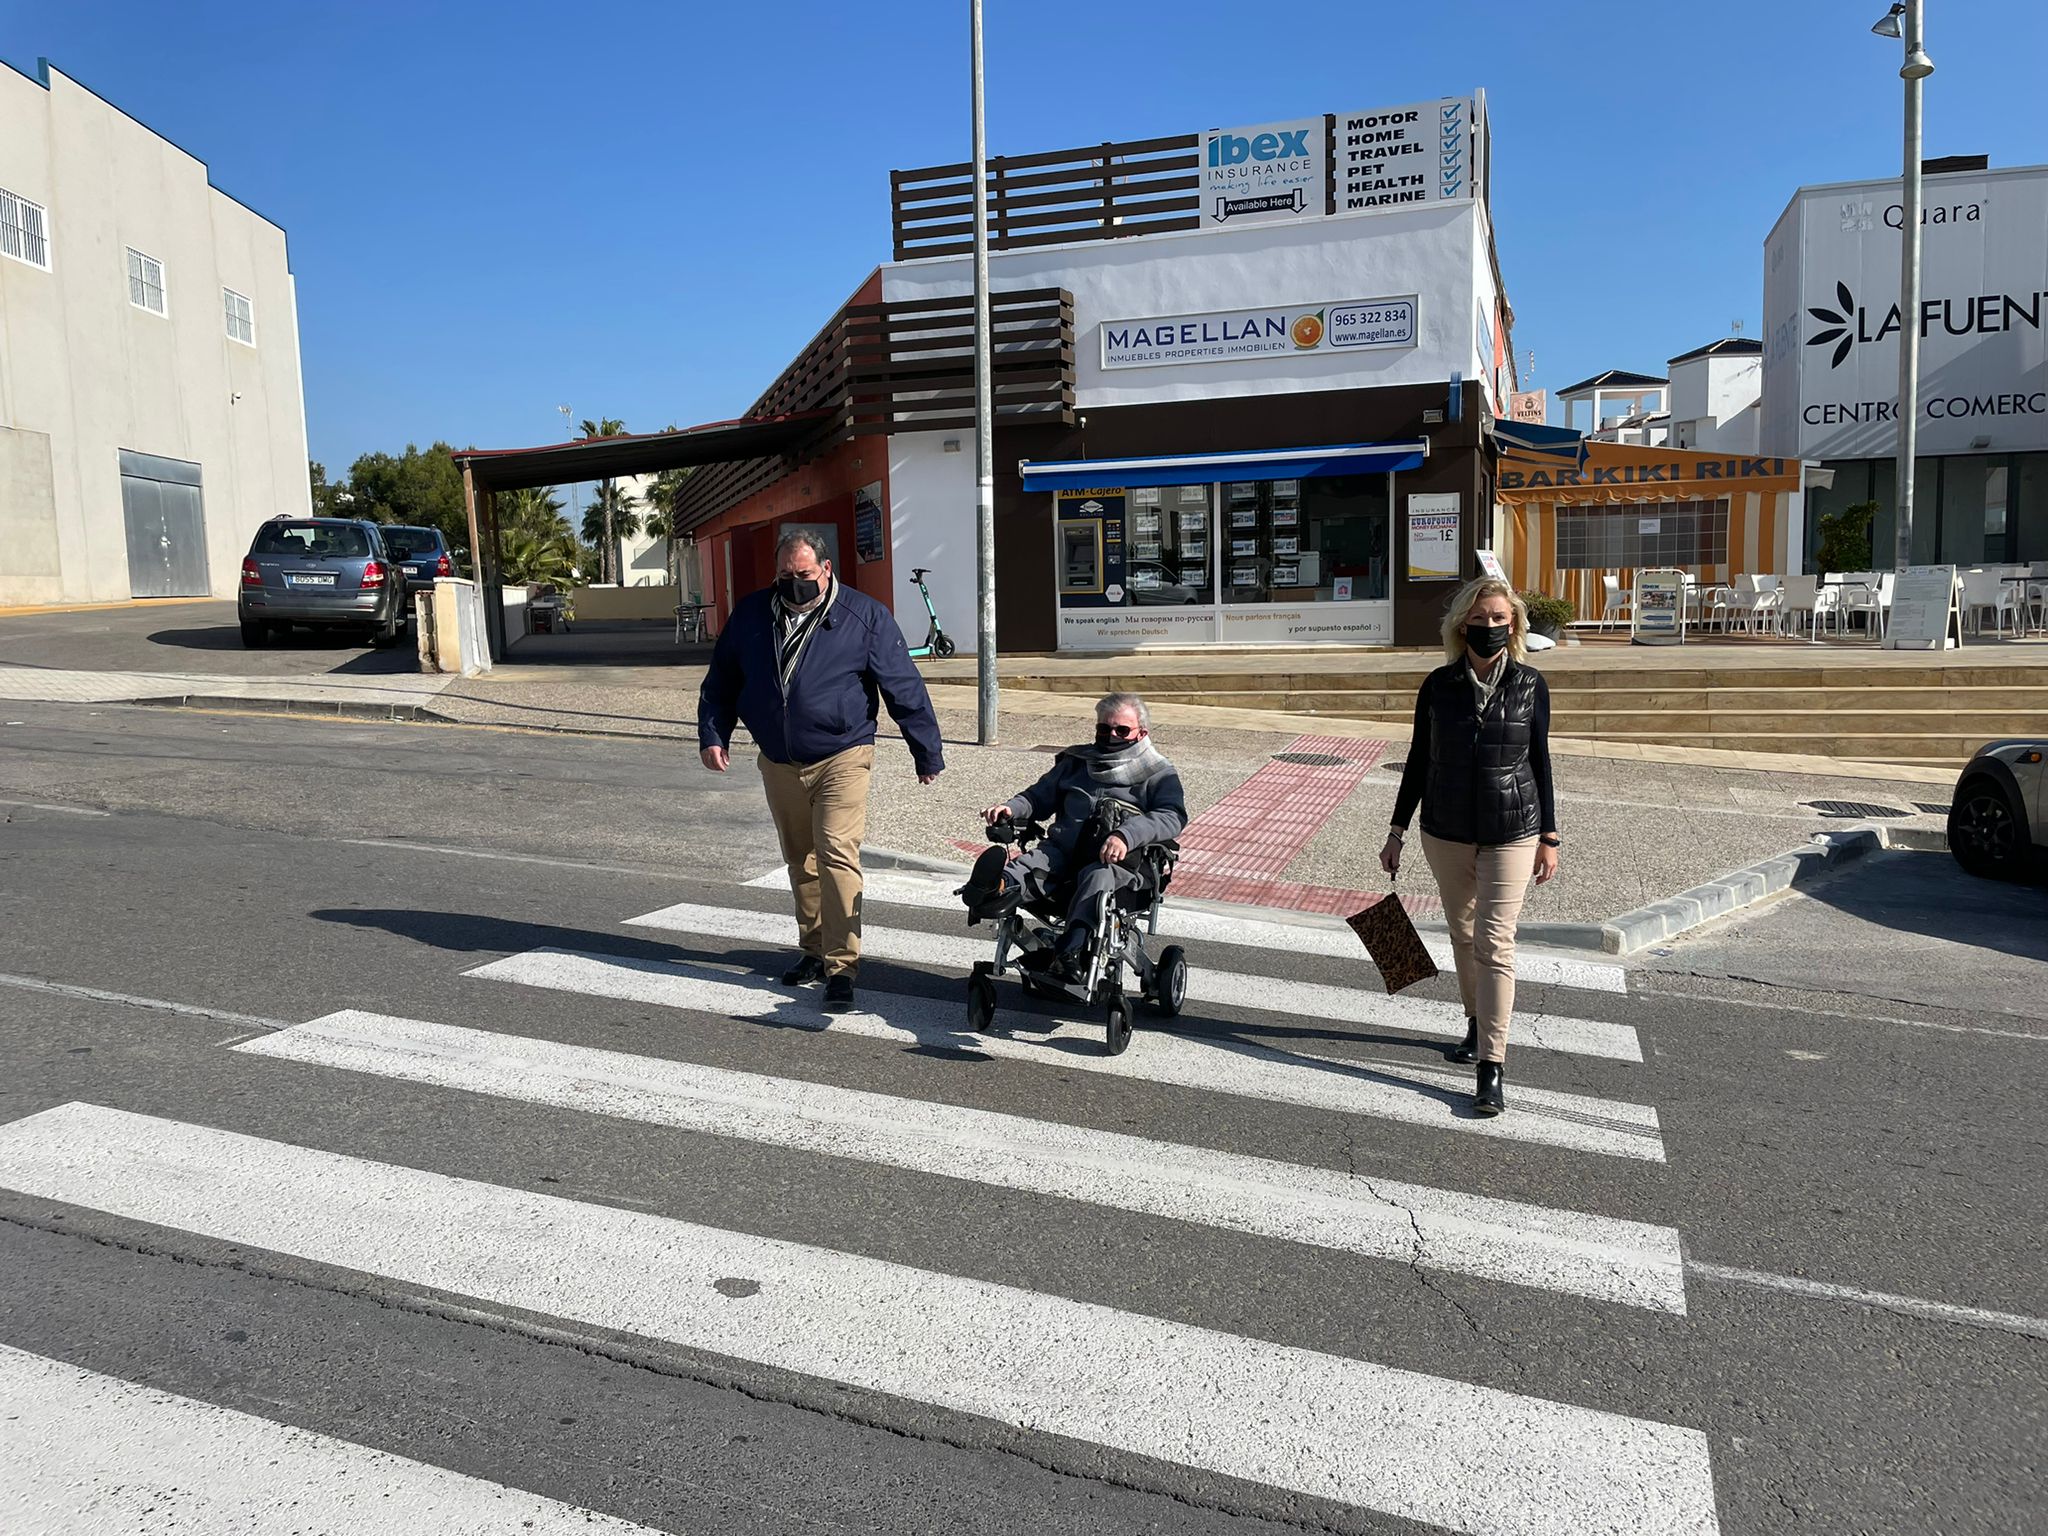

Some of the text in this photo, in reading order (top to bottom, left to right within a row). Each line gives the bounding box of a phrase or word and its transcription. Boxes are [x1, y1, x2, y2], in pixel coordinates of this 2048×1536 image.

[1347, 111, 1419, 131] MOTOR
[1347, 129, 1405, 147] HOME
[1208, 129, 1310, 168] ibex
[1347, 142, 1424, 162] TRAVEL
[1208, 160, 1312, 180] INSURANCE
[1347, 163, 1385, 178] PET
[1209, 175, 1315, 195] making life easier
[1347, 174, 1424, 194] HEALTH
[1226, 197, 1293, 212] Available Here
[1347, 190, 1426, 209] MARINE
[1334, 310, 1407, 327] 965 322 834
[1920, 291, 2048, 338] FUEN
[1108, 315, 1286, 350] MAGELLAN
[1334, 327, 1407, 343] www.magellan.es
[1107, 342, 1286, 363] INMUEBLES PROPERTIES IMMOBILIEN
[1501, 458, 1784, 489] BAR KIKI RIKI
[1439, 529, 1454, 542] 1£
[1076, 617, 1095, 625] speak
[1096, 616, 1120, 625] english
[1125, 614, 1214, 625] Мы говорим по-русски
[1245, 614, 1272, 623] parlons
[1272, 612, 1301, 622] français
[1109, 628, 1140, 637] sprechen
[1141, 627, 1169, 636] Deutsch
[1308, 625, 1341, 633] supuesto
[1342, 623, 1372, 632] español
